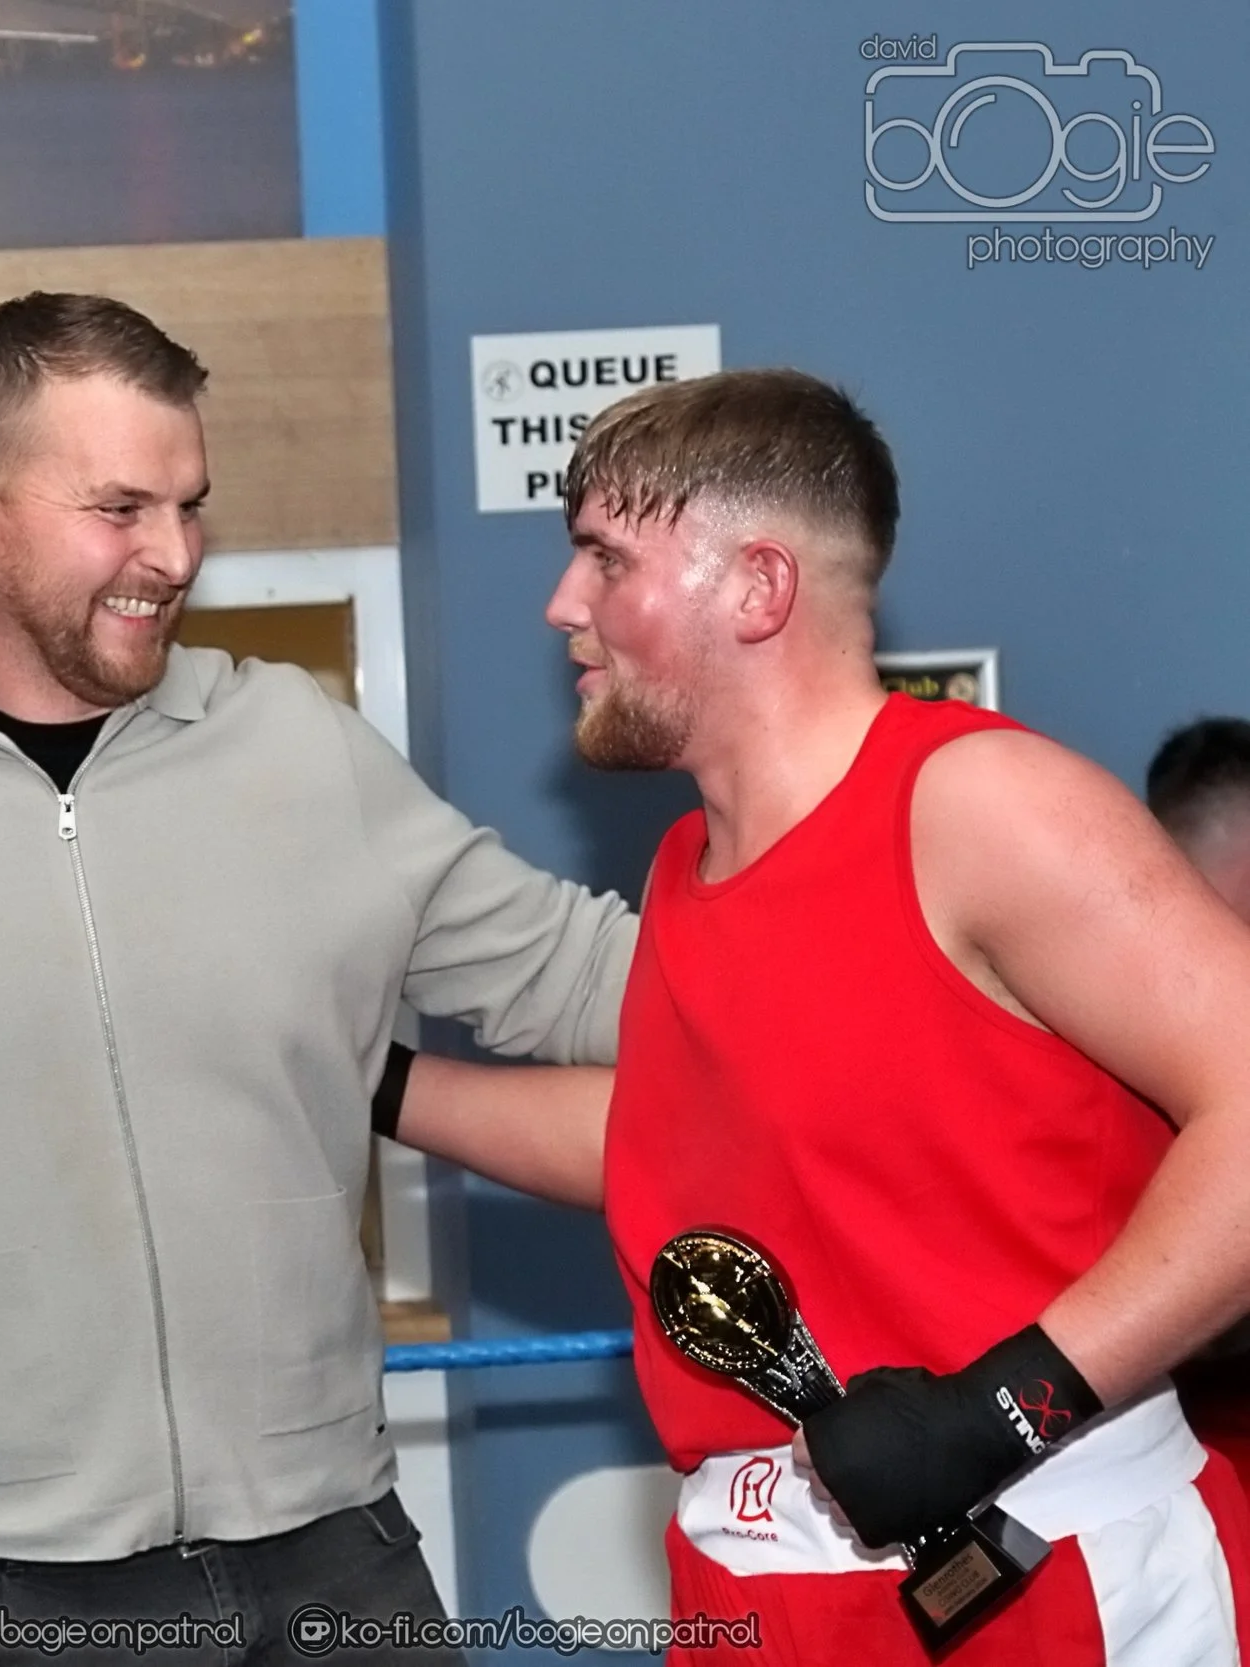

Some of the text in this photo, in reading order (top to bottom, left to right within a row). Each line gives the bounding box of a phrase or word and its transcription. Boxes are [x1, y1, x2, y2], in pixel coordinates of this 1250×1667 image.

[529, 354, 678, 390] QUEUE
[996, 1386, 1046, 1454] STING
[922, 1552, 974, 1598] Glenrothes
